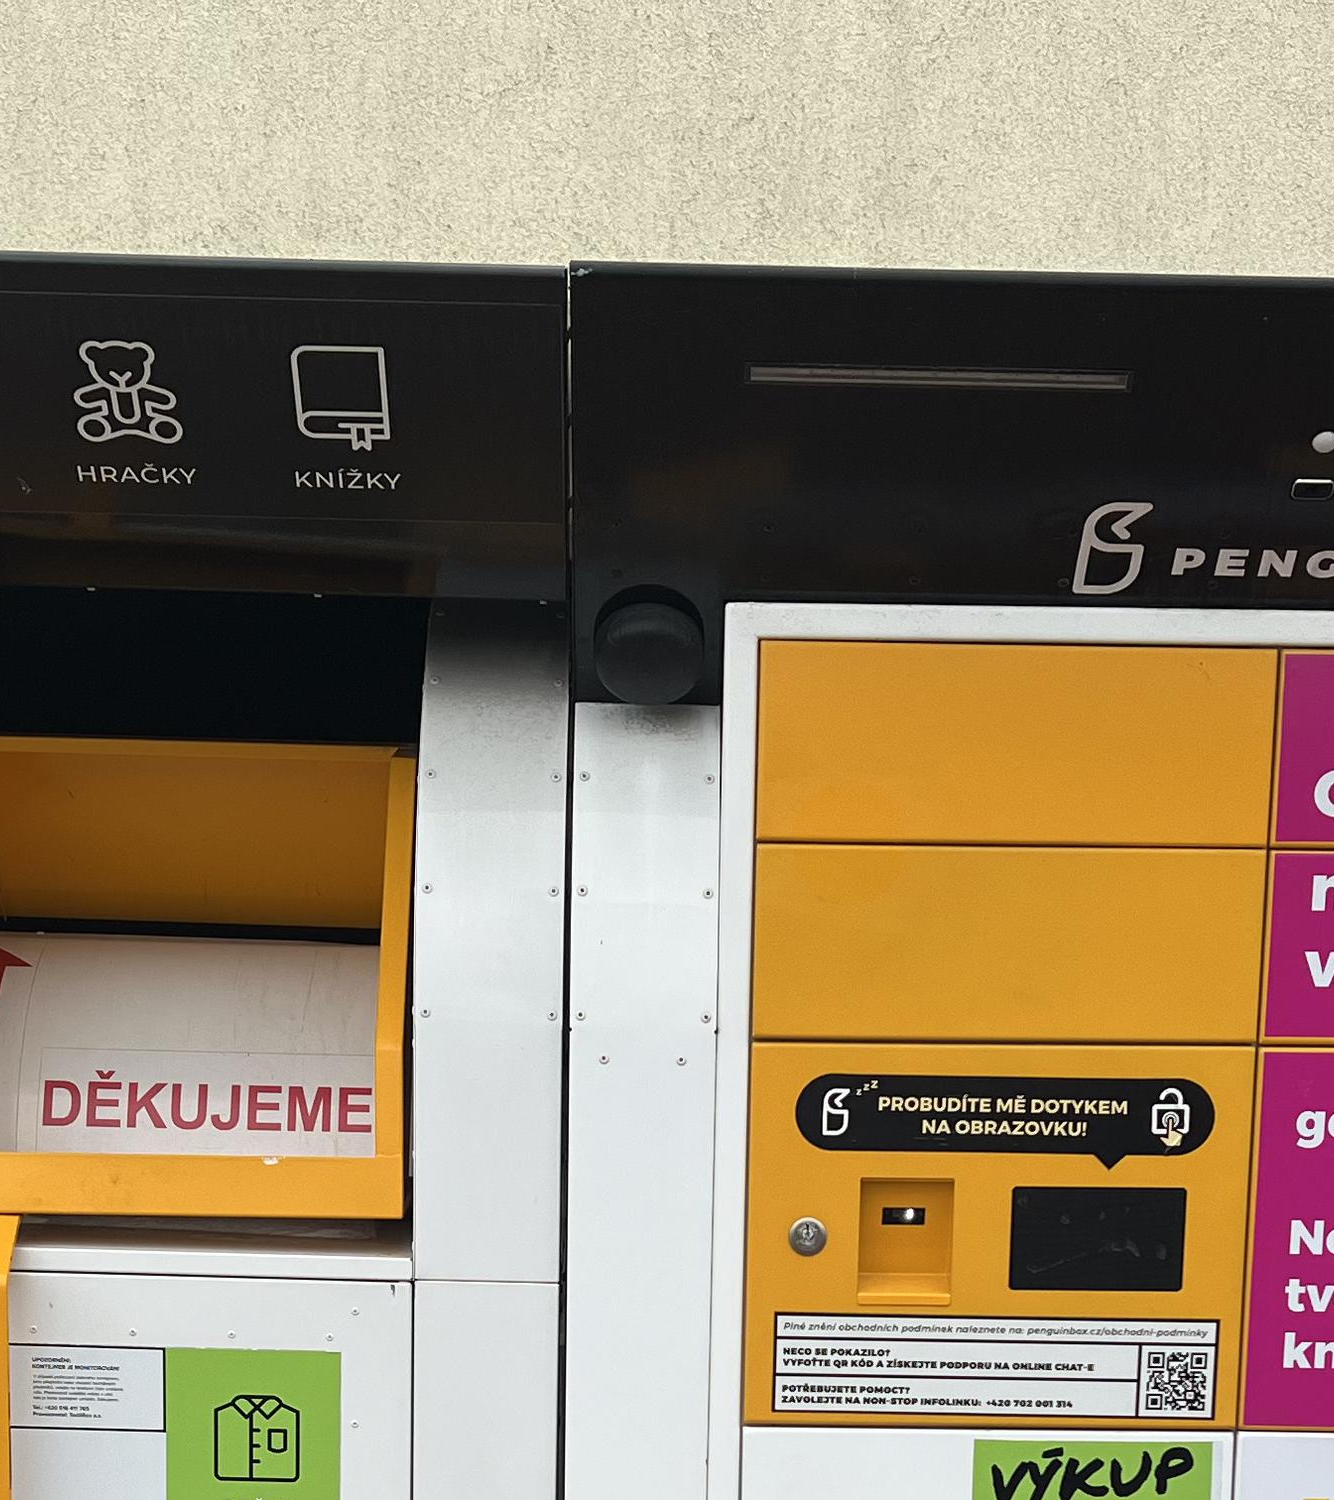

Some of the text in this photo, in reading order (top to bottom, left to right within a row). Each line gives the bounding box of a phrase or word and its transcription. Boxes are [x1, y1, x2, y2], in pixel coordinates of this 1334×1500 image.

[76, 461, 197, 486] HRAČKY
[294, 467, 402, 492] KNÍŽKY
[41, 1069, 374, 1135] DĚKUJEME
[878, 1095, 1128, 1115] PROBUDÍTE MĚ DOTYKEM
[921, 1119, 1087, 1137] NA OBRAZOVKU!
[815, 1348, 828, 1356] SE
[831, 1348, 891, 1357] POKAZILO?
[834, 1360, 848, 1368] QR
[851, 1358, 874, 1367] KÓD
[886, 1358, 937, 1368] ZÍSKEJTE
[940, 1361, 992, 1370] PODPORU
[994, 1362, 1010, 1370] NA
[1012, 1362, 1052, 1371] ONLINE
[782, 1383, 910, 1394] POTŘEBUJETE POMOCT?
[781, 1395, 843, 1404] ZAVOLEJTE
[845, 1397, 860, 1405] NA
[863, 1397, 918, 1406] NON-STOP
